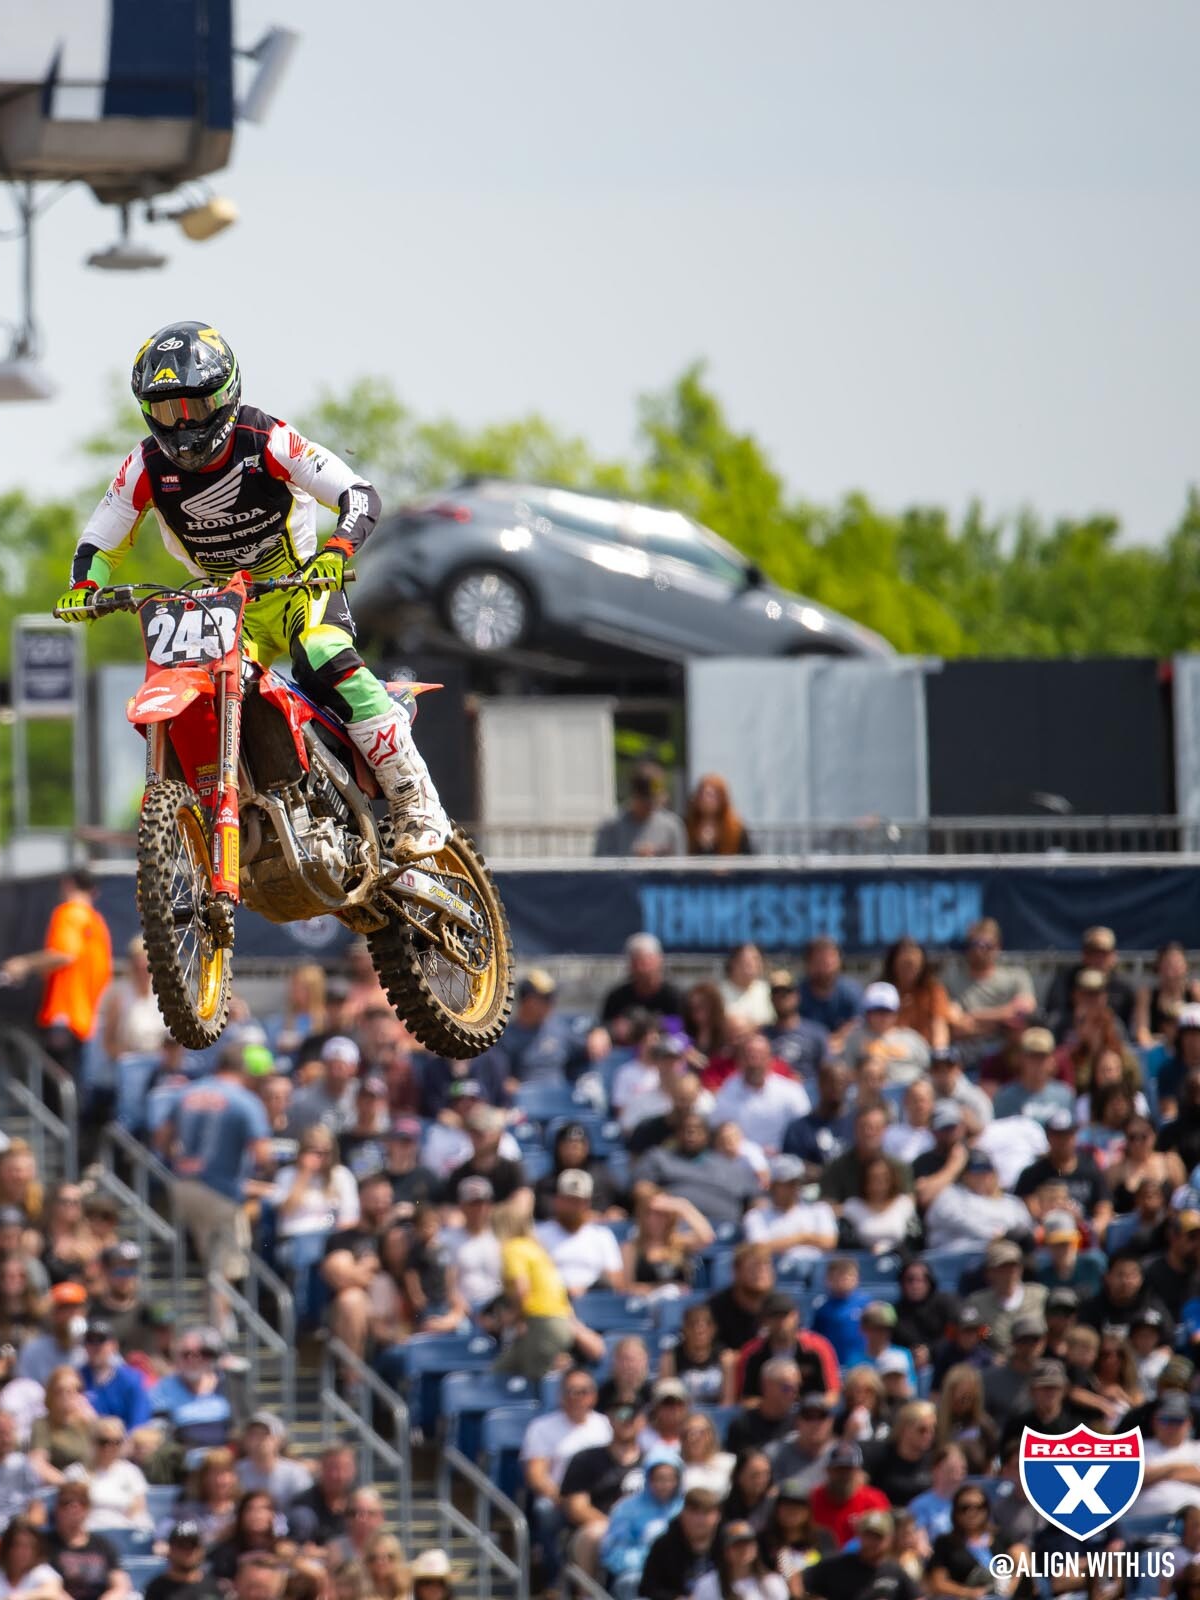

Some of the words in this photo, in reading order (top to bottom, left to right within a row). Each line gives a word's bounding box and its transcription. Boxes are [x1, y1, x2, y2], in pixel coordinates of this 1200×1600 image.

[148, 378, 181, 389] ARMA
[186, 507, 267, 531] HONDA
[232, 511, 282, 539] RACING
[195, 542, 259, 559] PHOENIX
[147, 606, 238, 666] 243
[640, 883, 846, 947] TENNESSEE
[856, 880, 983, 944] TOUGH
